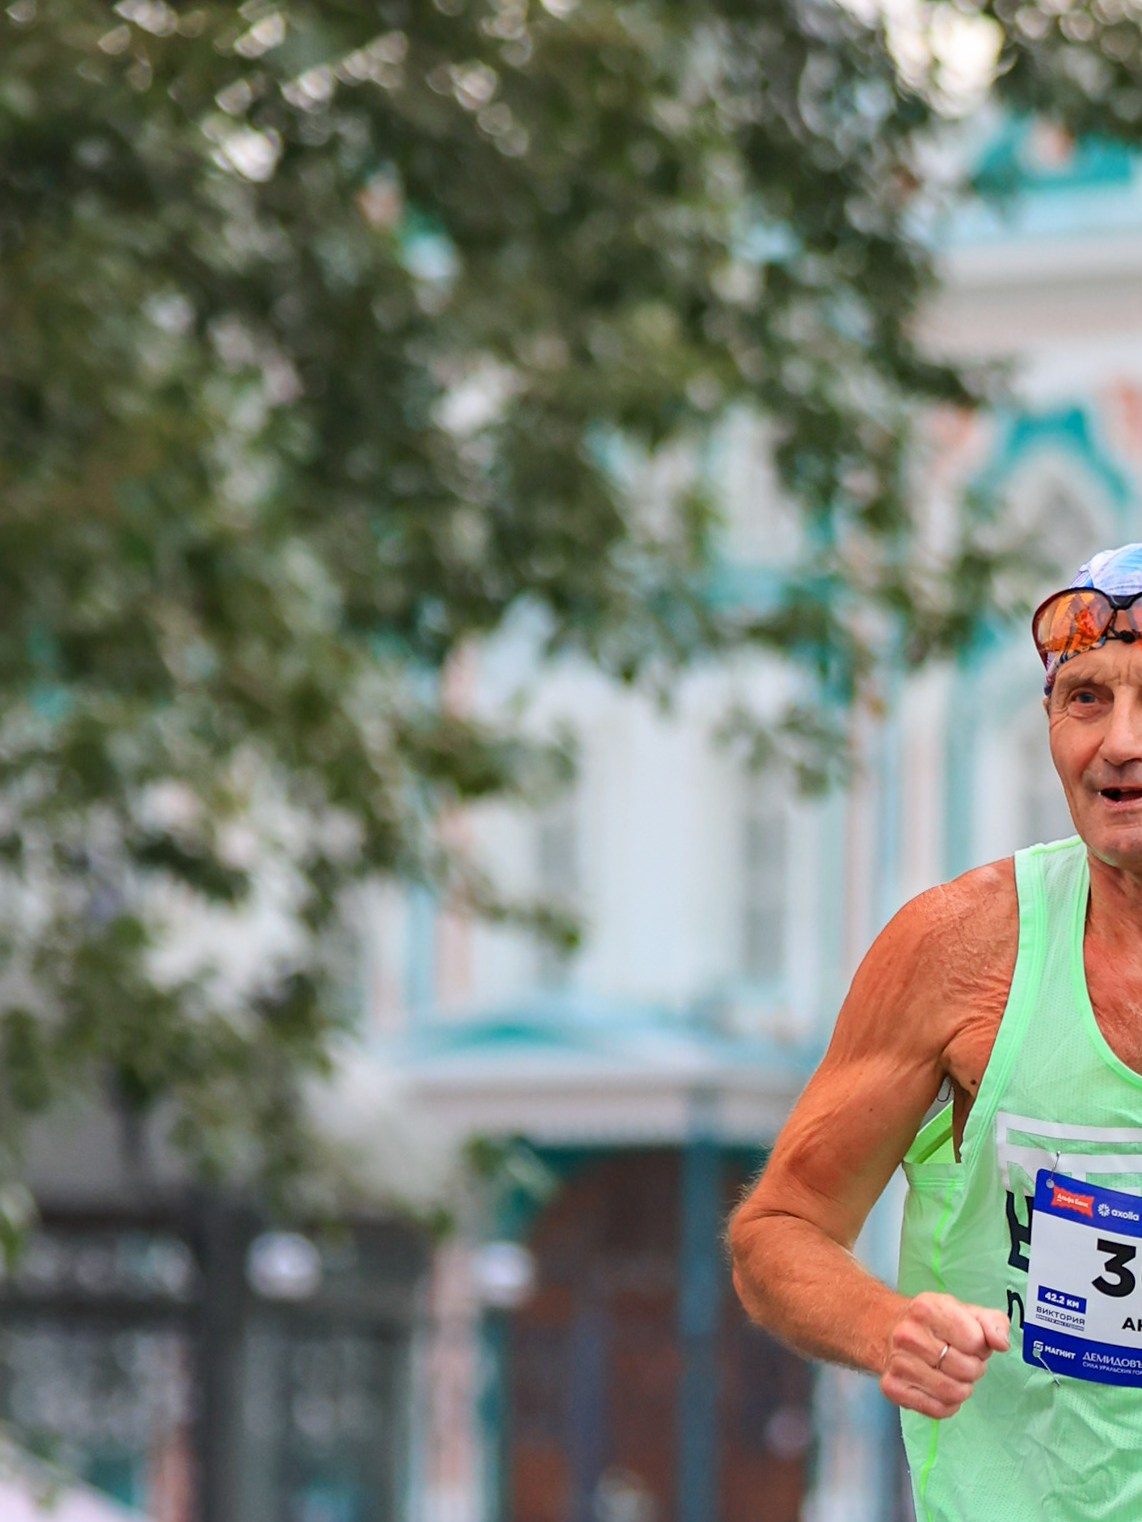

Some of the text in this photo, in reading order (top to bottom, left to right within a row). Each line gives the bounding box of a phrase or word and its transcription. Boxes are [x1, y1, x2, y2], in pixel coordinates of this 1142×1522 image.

[1111, 1209, 1140, 1222] axolla
[1044, 1291, 1065, 1305] 42.2
[1036, 1306, 1086, 1326] ВИКТОРИЯ
[1044, 1345, 1076, 1360] МАГНИТ
